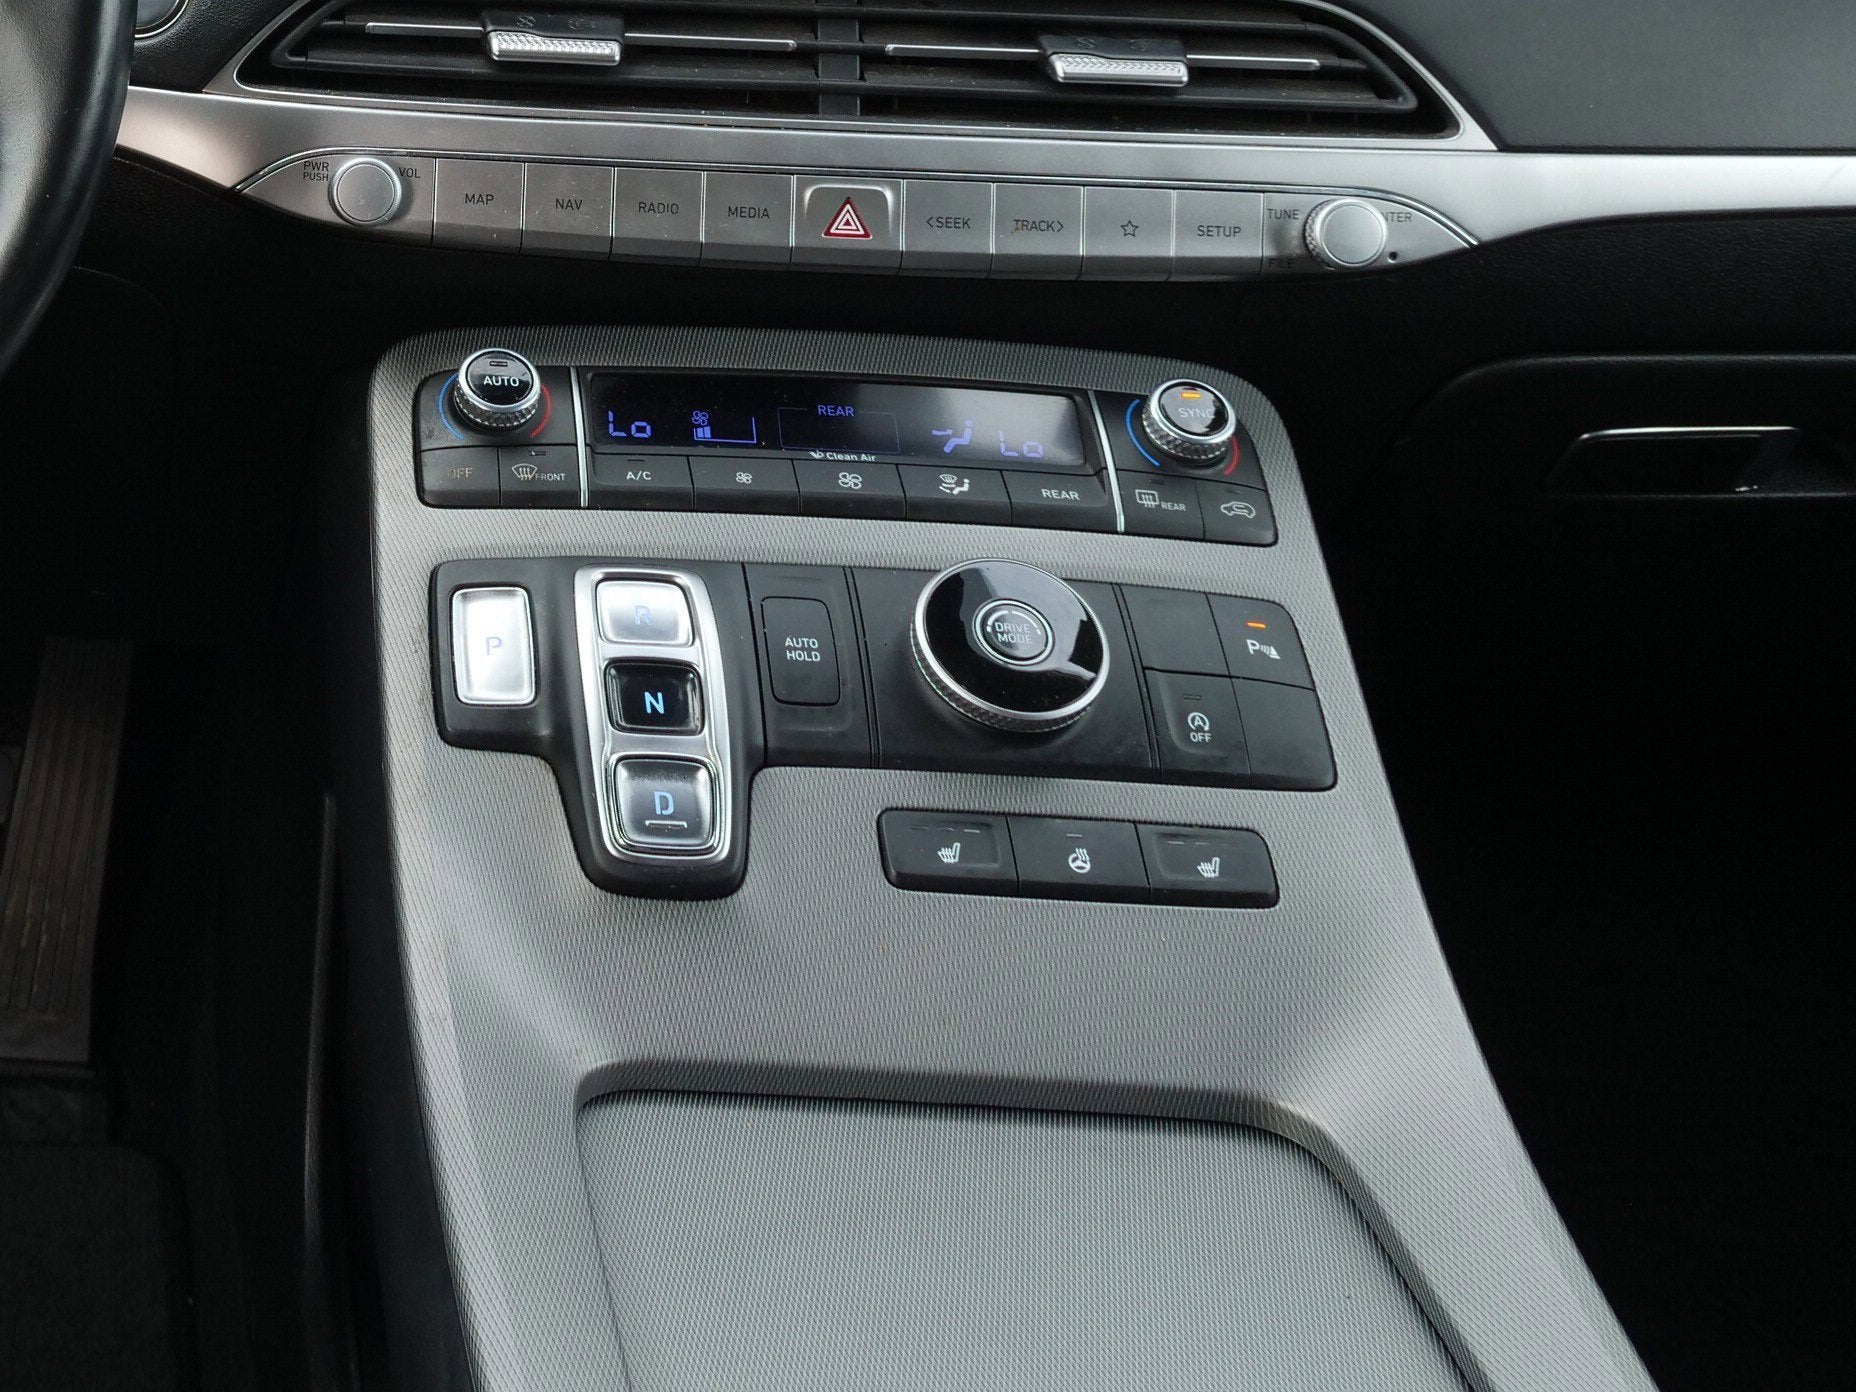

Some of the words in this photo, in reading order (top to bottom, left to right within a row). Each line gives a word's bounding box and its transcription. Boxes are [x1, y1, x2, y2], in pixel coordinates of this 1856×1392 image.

[303, 162, 329, 171] PWR
[303, 172, 329, 182] PUSH
[399, 167, 421, 179] VOL
[465, 193, 494, 206] MAP
[555, 198, 583, 210] NAV
[638, 202, 679, 214] RADIO
[727, 206, 770, 219] MEDIA
[1267, 209, 1300, 220] TUNE
[1381, 212, 1412, 223] NTER
[1197, 225, 1242, 238] SETUP
[483, 375, 520, 388] AUTO
[817, 405, 855, 417] REAR
[1178, 407, 1214, 419] SYNC
[826, 452, 858, 461] Clean
[860, 454, 877, 462] Air
[450, 467, 473, 480] OFF
[535, 472, 566, 482] FRONT
[626, 471, 652, 482] A/C
[1041, 487, 1080, 502] REAR
[1161, 501, 1186, 513] REAR
[634, 605, 652, 626] R
[995, 621, 1031, 633] DRIVE
[784, 636, 819, 650] AUTO
[997, 632, 1032, 644] MODE
[486, 636, 503, 656] P
[786, 650, 821, 663] HOLD
[645, 691, 664, 714] N
[1190, 732, 1212, 744] OFF
[654, 791, 675, 815] D
